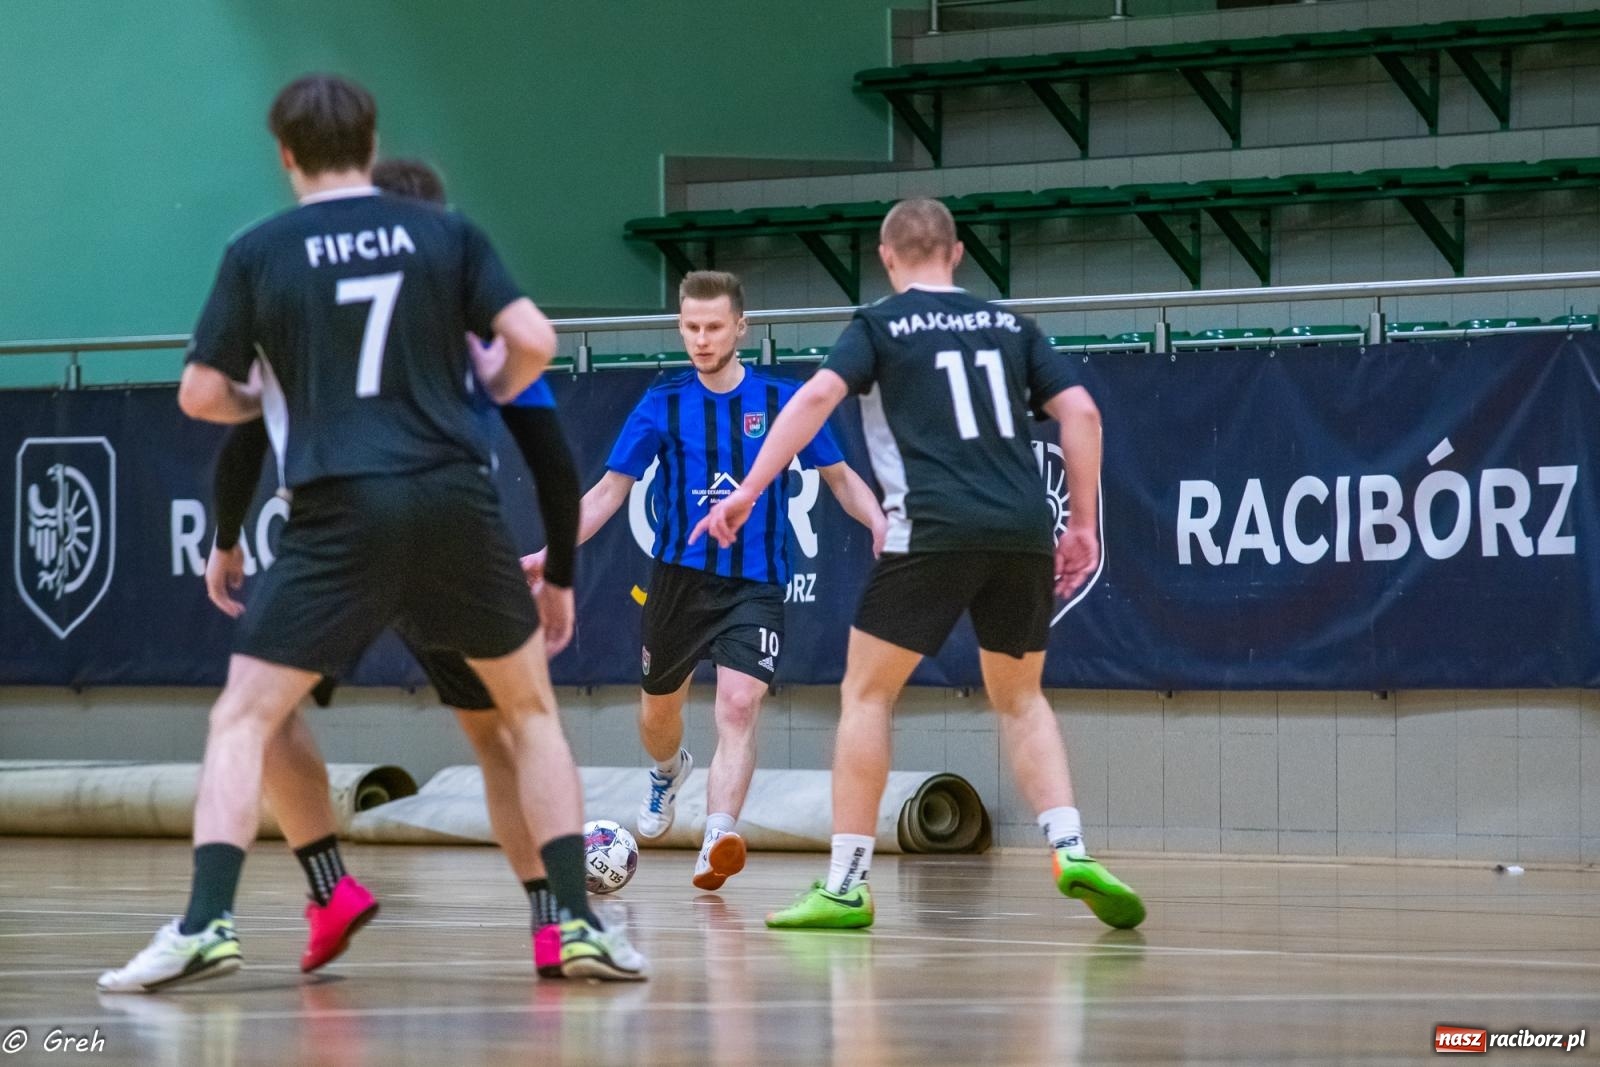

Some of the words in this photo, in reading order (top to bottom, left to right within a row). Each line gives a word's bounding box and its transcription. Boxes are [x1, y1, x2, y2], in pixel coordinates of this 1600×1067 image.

[304, 224, 416, 268] FIFCIA
[335, 270, 404, 398] 7
[888, 311, 992, 338] MAJCHER
[935, 349, 1015, 440] 11
[1177, 437, 1578, 566] RACIBÓRZ
[758, 627, 779, 657] 10
[589, 856, 624, 884] SELECT
